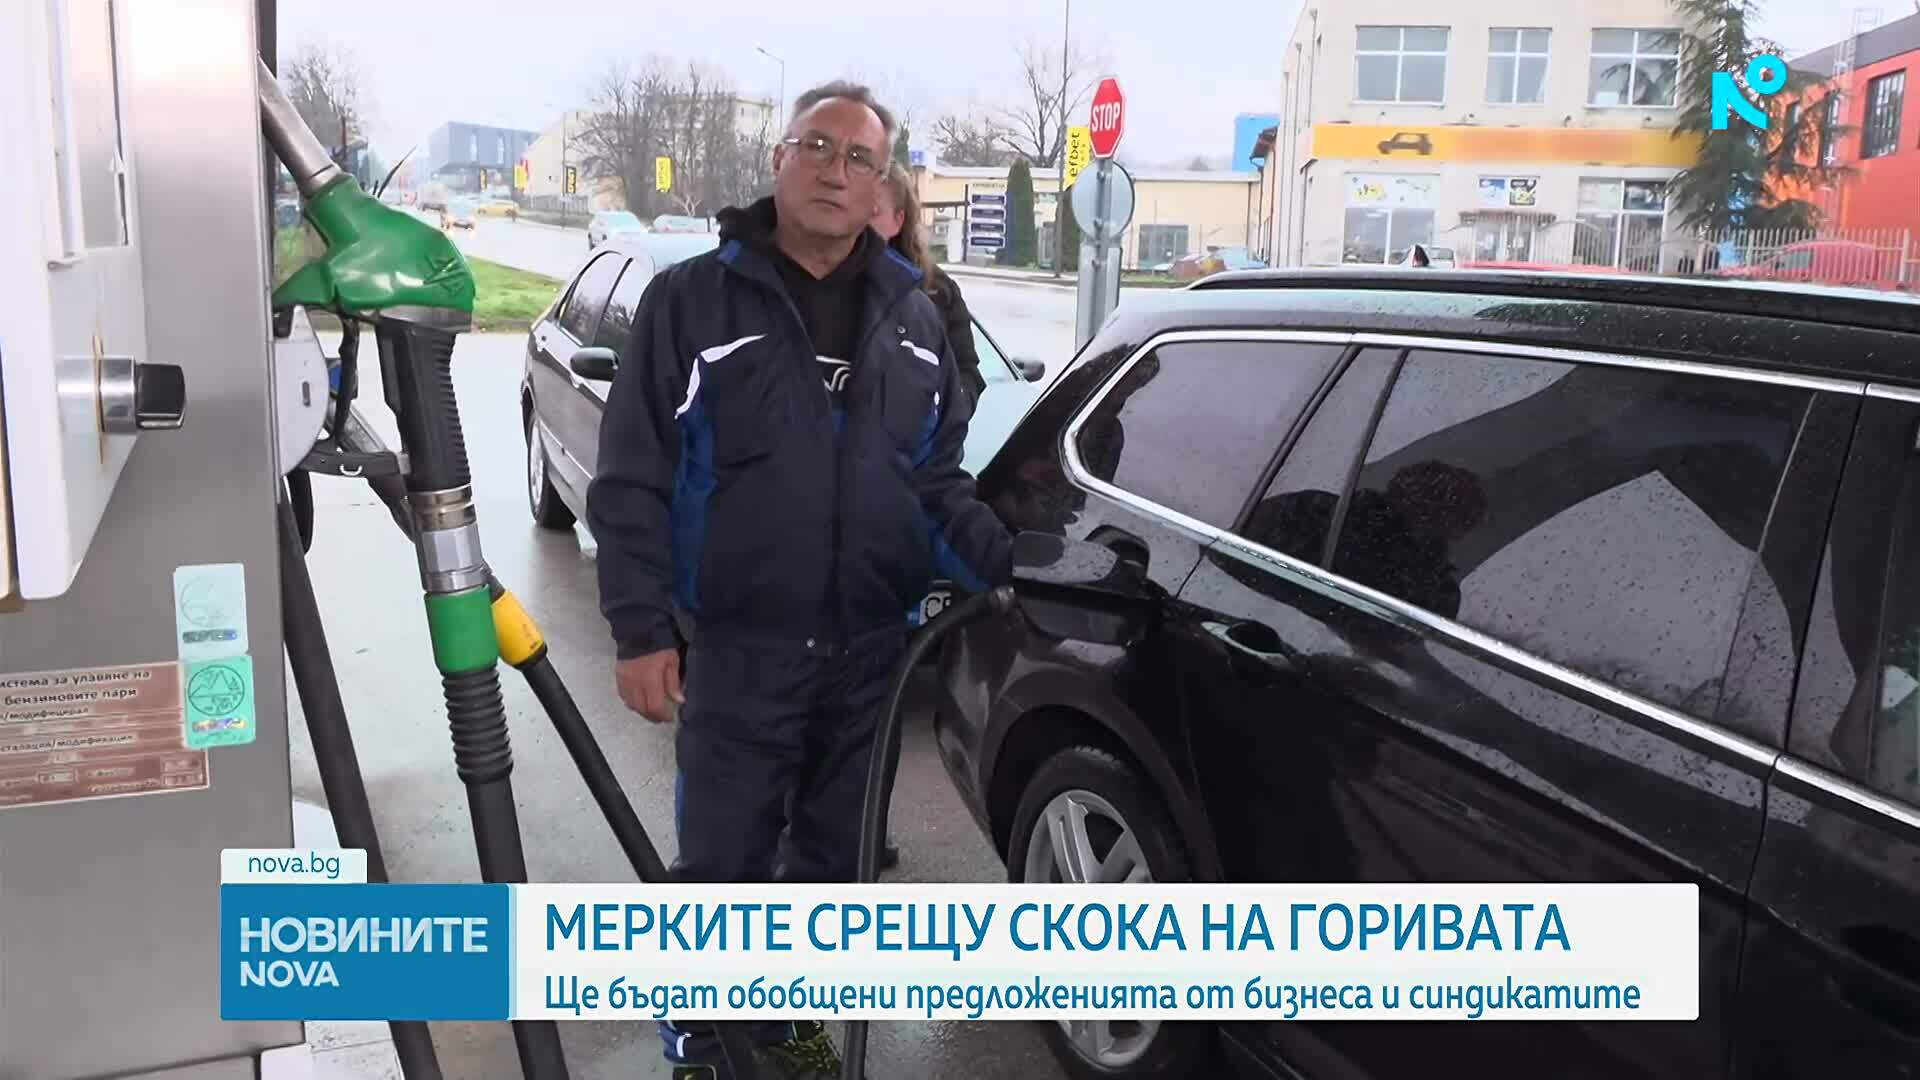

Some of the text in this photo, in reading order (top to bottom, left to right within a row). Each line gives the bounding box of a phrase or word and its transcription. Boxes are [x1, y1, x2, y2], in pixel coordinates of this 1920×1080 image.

[1091, 102, 1121, 132] STOP
[1068, 132, 1080, 177] efbet
[55, 676, 68, 686] за
[133, 670, 151, 680] на
[4, 688, 137, 706] бензиновите пари
